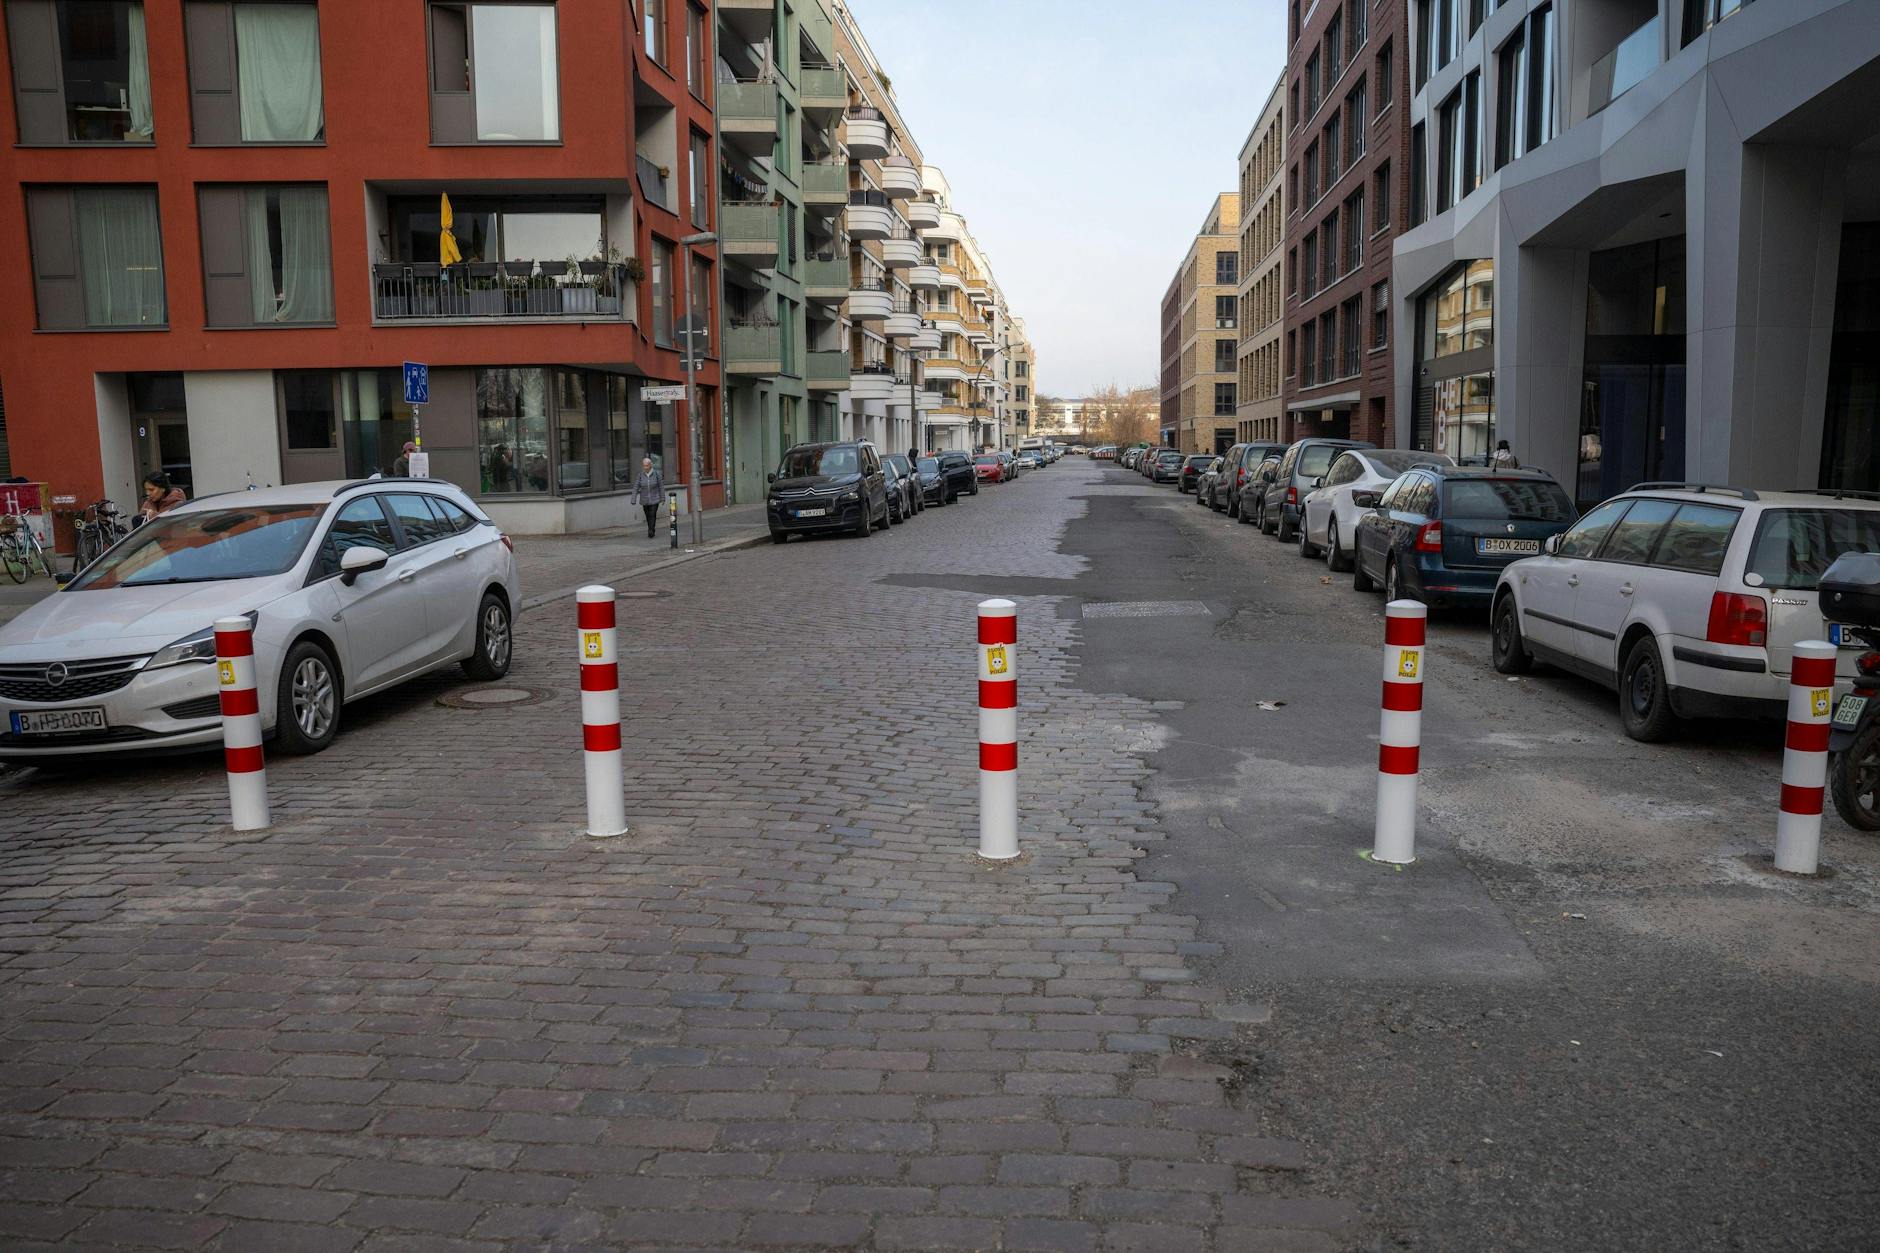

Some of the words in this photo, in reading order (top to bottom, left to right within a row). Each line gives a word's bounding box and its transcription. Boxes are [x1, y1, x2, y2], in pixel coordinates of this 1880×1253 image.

[1434, 378, 1456, 412] THE
[139, 427, 146, 437] 9
[1485, 540, 1492, 550] B
[1842, 627, 1852, 643] B
[1842, 697, 1863, 710] 508
[1837, 710, 1858, 722] GER
